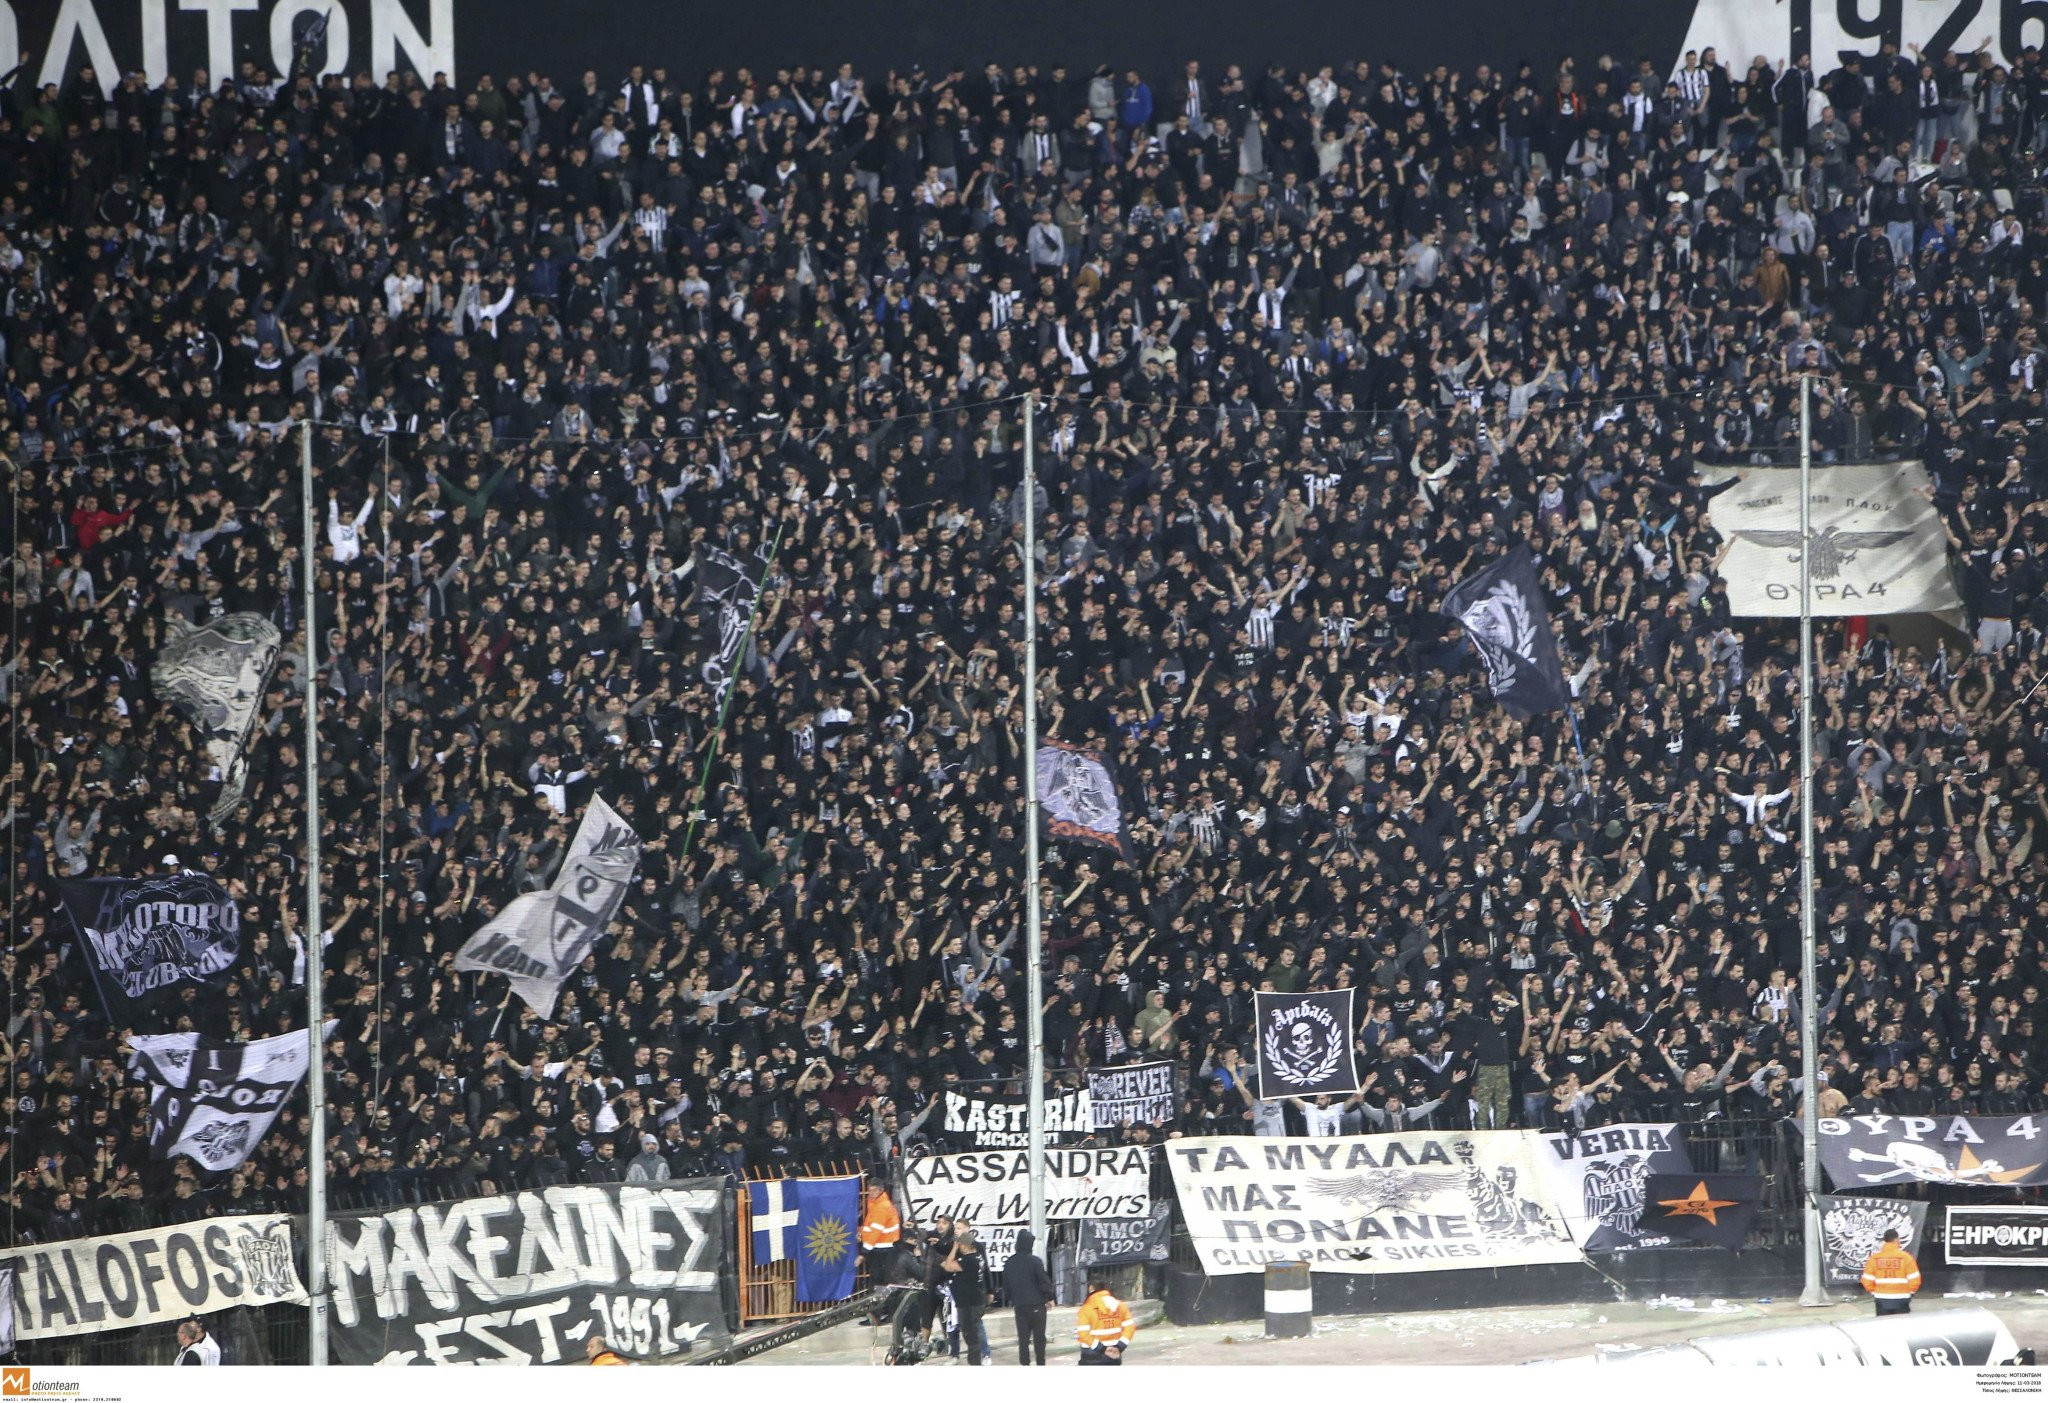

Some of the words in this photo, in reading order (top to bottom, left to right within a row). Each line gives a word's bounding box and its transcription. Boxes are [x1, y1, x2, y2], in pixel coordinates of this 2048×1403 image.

[1867, 582, 1887, 597] 4
[944, 1090, 1095, 1133] KASTRIA
[2007, 1116, 2041, 1140] 4
[1175, 1145, 1249, 1173] ΤΑ
[1263, 1140, 1452, 1171] ΜΥΑΛΑ
[1550, 1129, 1672, 1161] VERIA
[1201, 1183, 1302, 1213] ΜΑΣ
[1222, 1214, 1474, 1244] ΠΟΝΑΝΕ
[1100, 1239, 1144, 1256] 1926
[1383, 1244, 1482, 1262] SIKIES
[1640, 1236, 1671, 1249] 1990
[1914, 1346, 1950, 1366] GR
